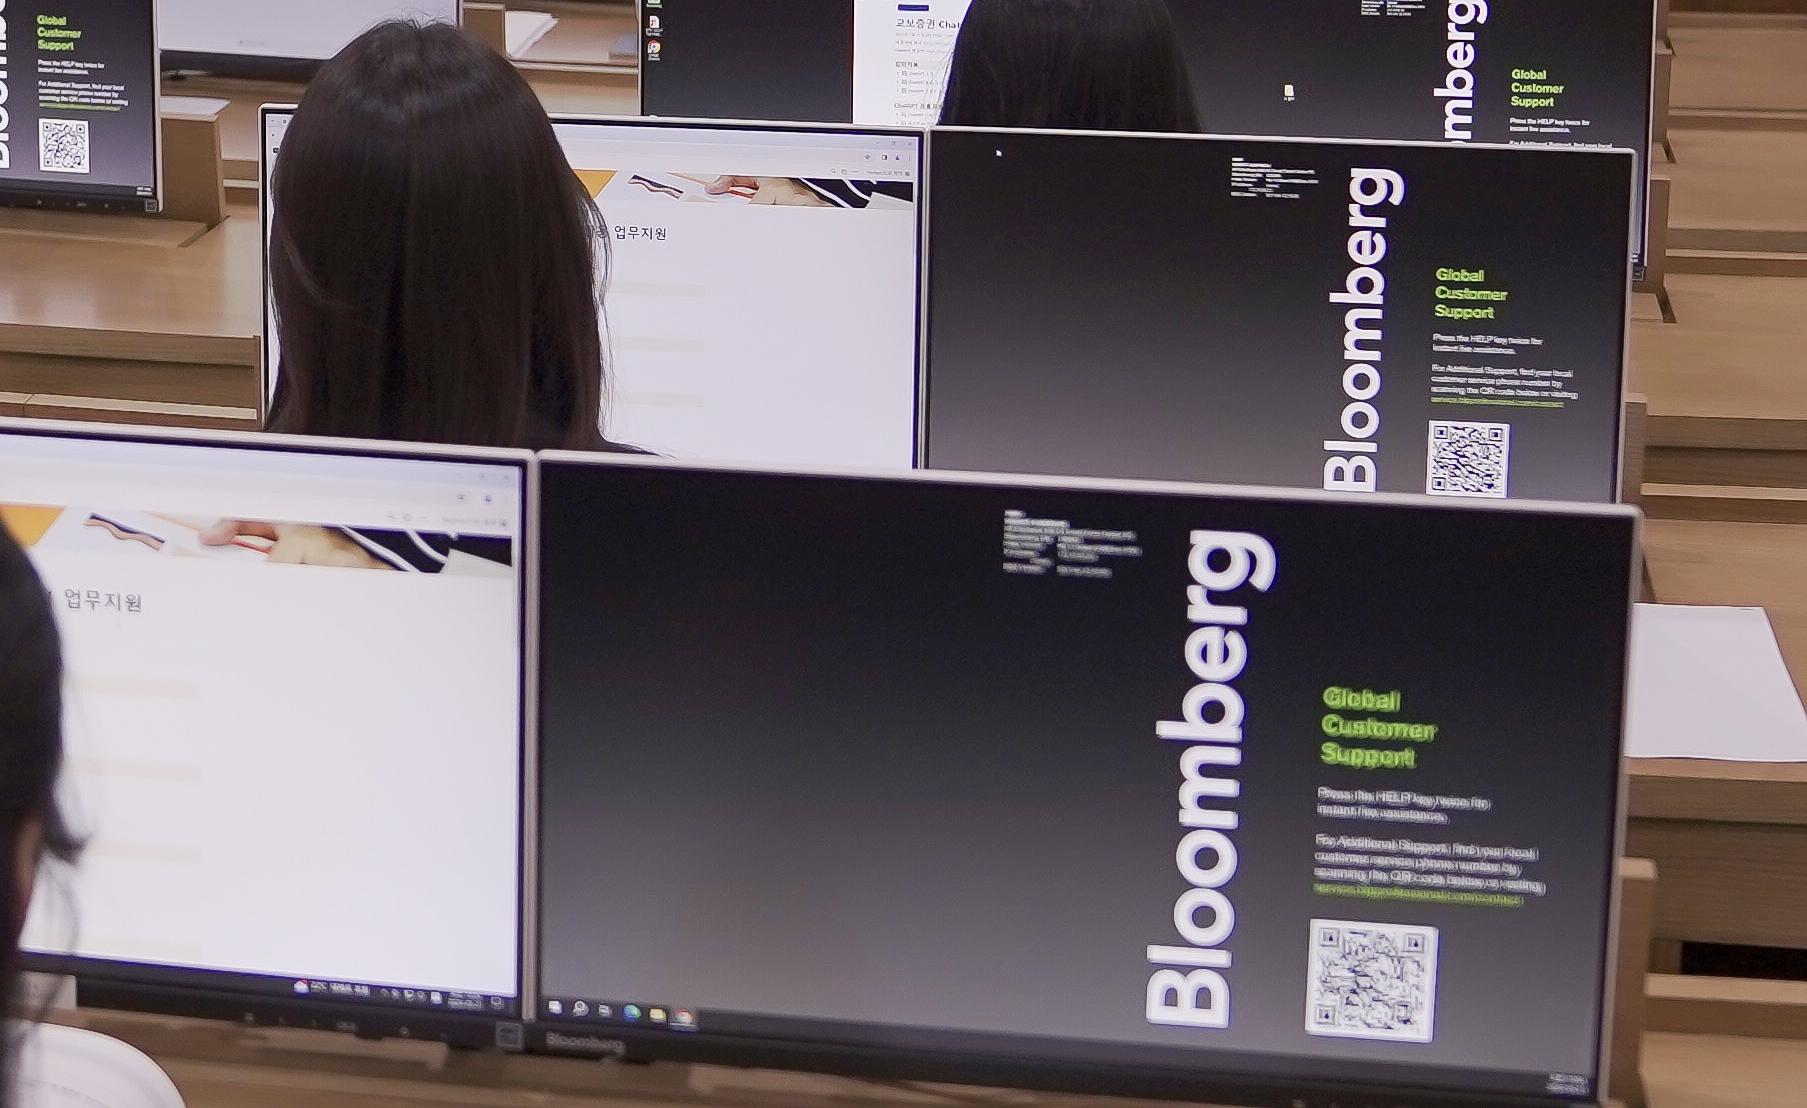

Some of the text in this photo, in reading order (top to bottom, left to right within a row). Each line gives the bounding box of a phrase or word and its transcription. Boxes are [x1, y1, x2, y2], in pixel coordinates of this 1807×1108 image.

[37, 14, 67, 26] Global
[896, 18, 935, 29] 교보증권
[37, 26, 82, 39] Customer
[37, 40, 74, 51] Support
[1511, 69, 1547, 80] Global
[1511, 82, 1565, 94] Customer
[1511, 96, 1554, 109] Support
[614, 225, 667, 241] 업무지원
[1435, 267, 1485, 282] Global
[1435, 285, 1509, 301] Customer
[1434, 304, 1495, 320] Support
[1322, 167, 1405, 492] Bloomberg
[65, 589, 142, 613] 업무지원
[1323, 686, 1401, 713] Global
[1321, 713, 1439, 742] Customer
[1320, 741, 1417, 770] Support
[1146, 528, 1278, 1030] Bloomberg
